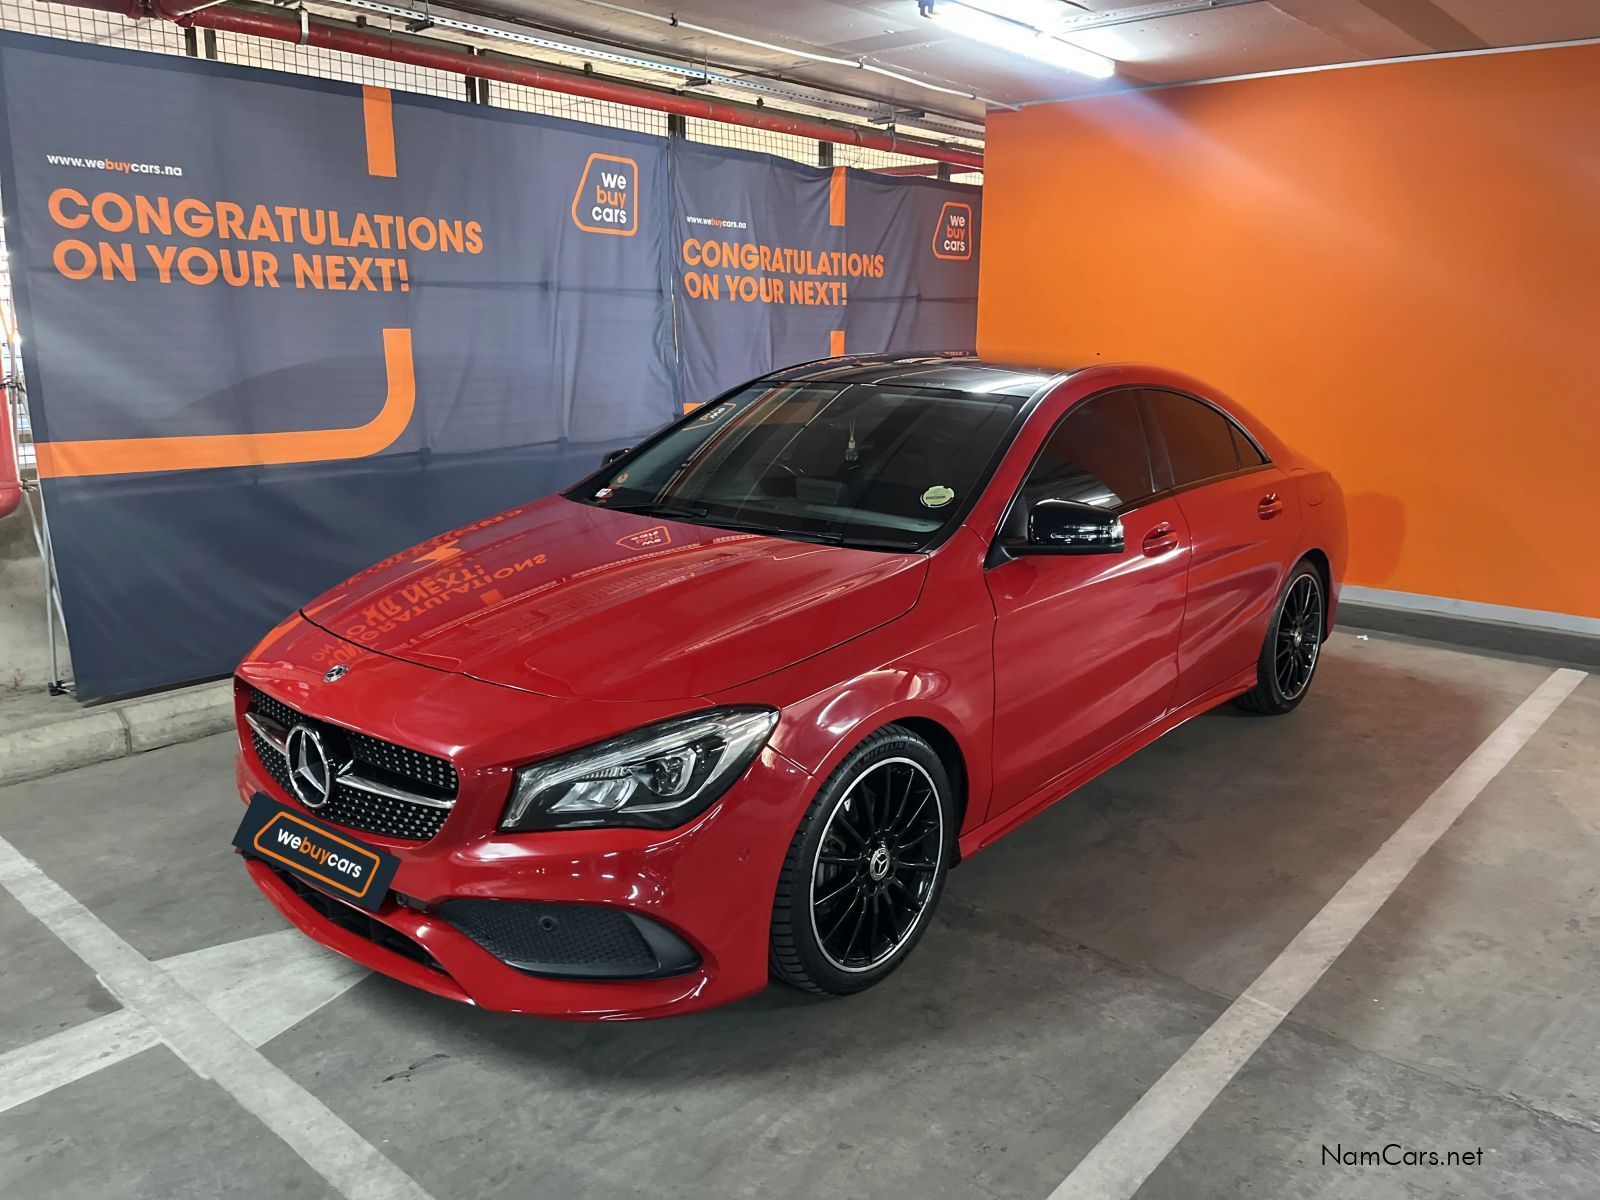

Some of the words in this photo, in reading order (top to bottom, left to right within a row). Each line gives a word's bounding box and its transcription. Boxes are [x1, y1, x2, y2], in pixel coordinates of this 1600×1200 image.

[46, 153, 183, 177] www.webuycars.na
[601, 171, 627, 190] we
[596, 185, 627, 210] buy
[48, 188, 484, 254] CONGRATULATIONS
[592, 206, 627, 224] cars
[686, 216, 747, 229] www.webuycars.na
[950, 215, 966, 227] we
[947, 224, 966, 240] buy
[682, 238, 885, 278] CONGRATULATIONS
[943, 240, 966, 252] cars
[52, 239, 137, 282] ON
[146, 244, 280, 288] YOUR
[293, 253, 410, 292] NEXT!
[684, 271, 719, 300] ON
[725, 275, 784, 304] YOUR
[789, 280, 848, 306] NEXT!
[277, 827, 363, 878] webuycars
